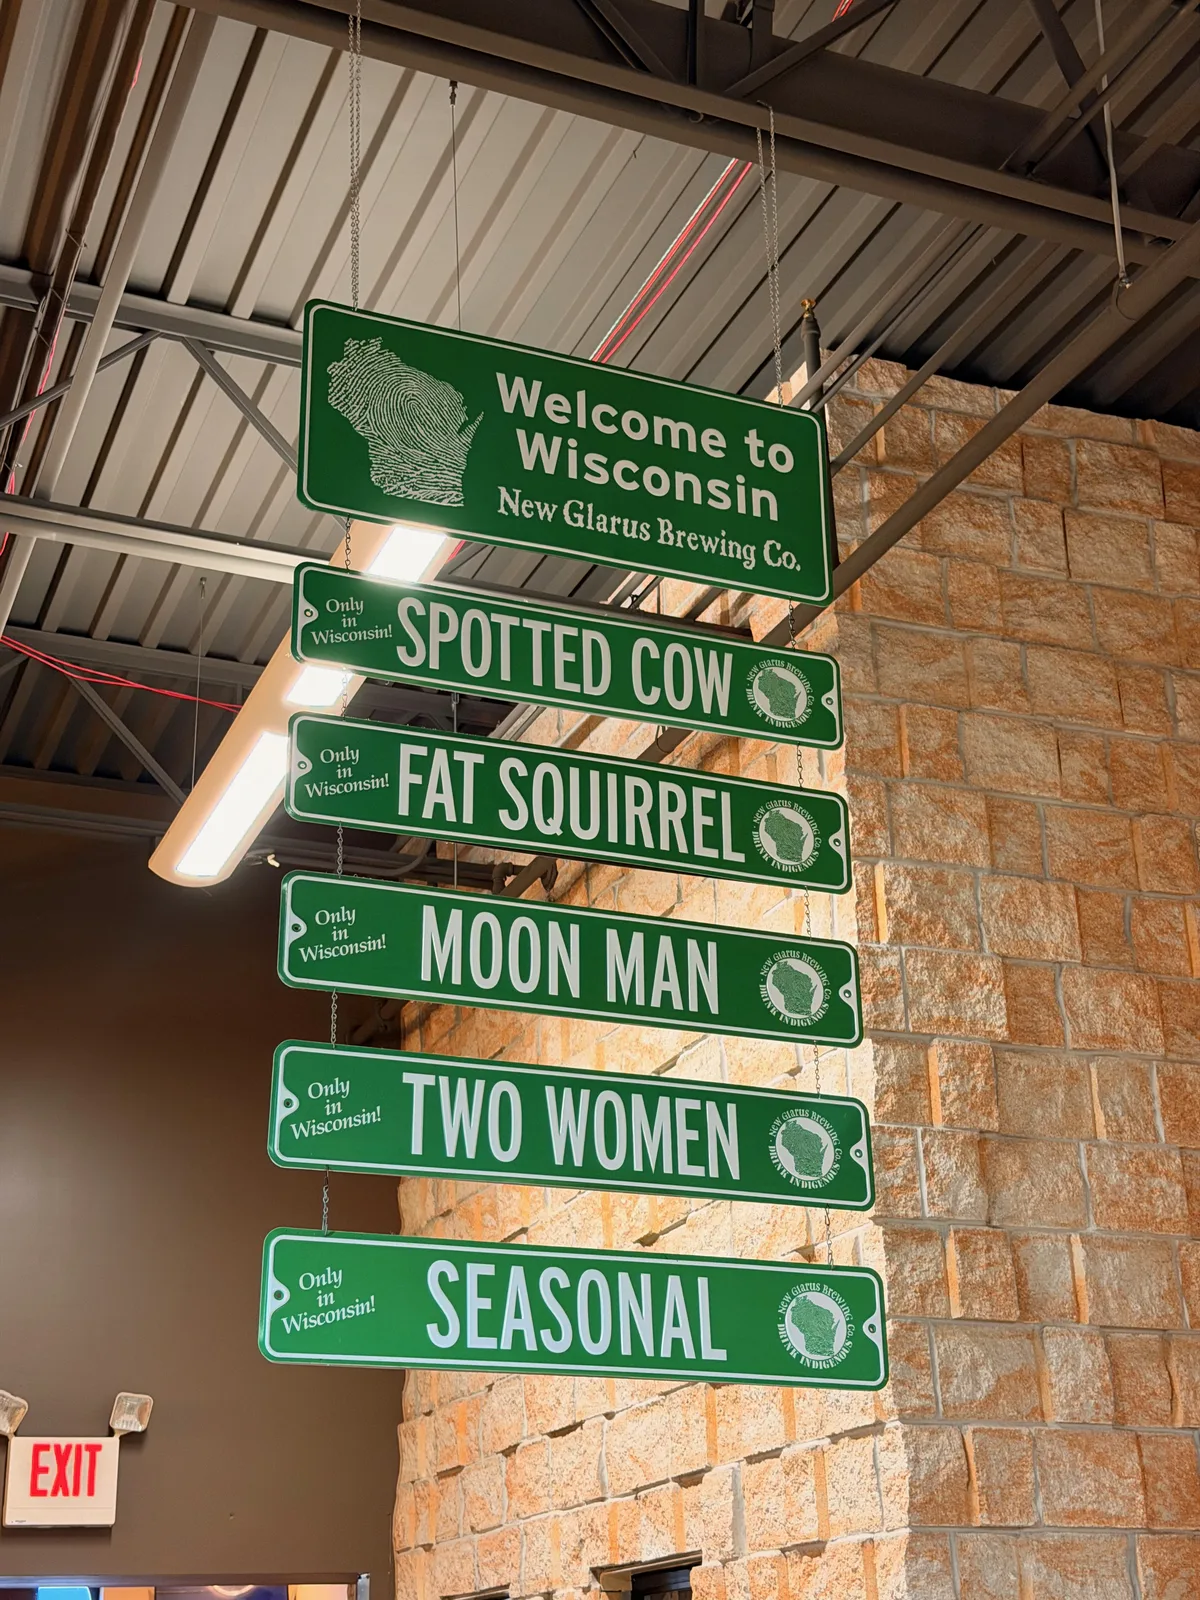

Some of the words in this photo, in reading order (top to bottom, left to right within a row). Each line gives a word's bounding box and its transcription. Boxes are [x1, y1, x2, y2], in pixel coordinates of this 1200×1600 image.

[495, 371, 727, 459] Welcome
[744, 428, 796, 473] to
[515, 428, 779, 522] Wisconsin
[497, 486, 558, 522] New
[563, 499, 651, 541] Glarus
[657, 517, 756, 570] Brewing
[763, 540, 801, 571] Co.
[326, 597, 364, 615] Only
[341, 614, 357, 628] in
[310, 624, 392, 645] Wisconsin!
[396, 596, 612, 696] SPOTTED
[631, 637, 733, 718] COW
[746, 688, 763, 718] DRINK
[764, 709, 812, 728] INDIGENOUS
[320, 746, 360, 765] Only
[336, 764, 353, 779] in
[304, 773, 389, 798] Wisconsin!
[398, 742, 485, 825] FAT
[498, 757, 745, 863] SQUIRREL
[752, 831, 770, 862] DRINK
[771, 850, 819, 873] INDIGENOUS
[315, 906, 356, 926] Only
[331, 926, 349, 941] in
[298, 933, 386, 963] Wisconsin!
[420, 904, 580, 998] MOON
[605, 927, 719, 1015] MAN
[759, 984, 779, 1016] DRINK
[779, 1002, 829, 1027] INDIGENOUS
[308, 1077, 350, 1099] Only
[324, 1099, 343, 1116] in
[290, 1105, 381, 1140] Wisconsin!
[402, 1072, 522, 1163] TWO
[544, 1085, 741, 1181] WOMEN
[768, 1146, 788, 1178] DRINK
[789, 1163, 840, 1189] INDIGENOUS
[299, 1266, 343, 1290] Only
[281, 1295, 375, 1334] Wisconsin!
[317, 1290, 335, 1307] in
[426, 1259, 728, 1361] SEASONAL
[777, 1324, 799, 1359] DRINK
[799, 1340, 853, 1369] INDIGENOUS
[29, 1443, 103, 1497] EXIT
